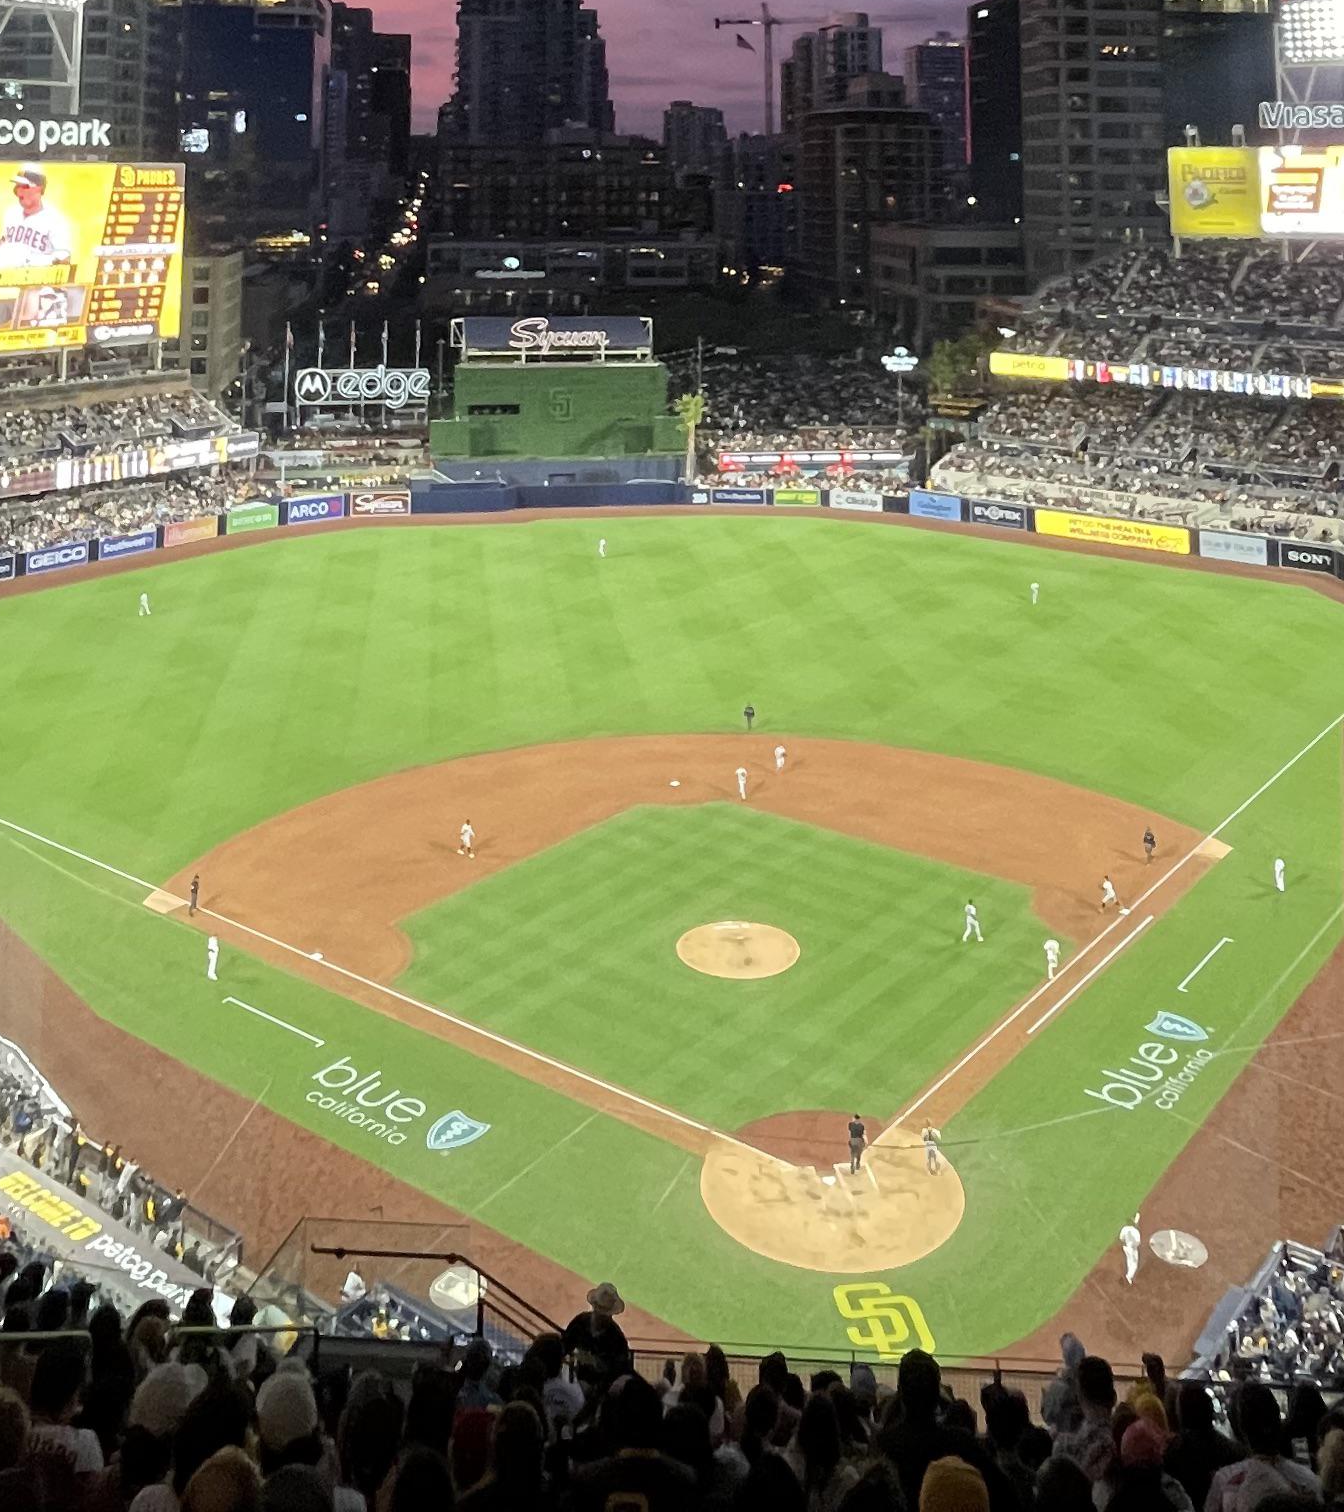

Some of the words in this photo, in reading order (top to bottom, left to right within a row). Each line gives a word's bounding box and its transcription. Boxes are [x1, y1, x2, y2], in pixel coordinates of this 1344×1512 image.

[39, 119, 111, 153] park
[509, 317, 609, 352] Sycuan
[337, 364, 431, 409] edge
[290, 502, 329, 519] ARCO
[844, 495, 878, 508] ClickUp
[1112, 533, 1155, 546] COMPANY
[29, 545, 86, 570] GEICO
[1287, 550, 1332, 566] SONY
[312, 1056, 427, 1123] blue
[1083, 1042, 1179, 1110] blue
[1155, 1048, 1213, 1110] california
[306, 1091, 407, 1145] california
[85, 1233, 153, 1281] petco
